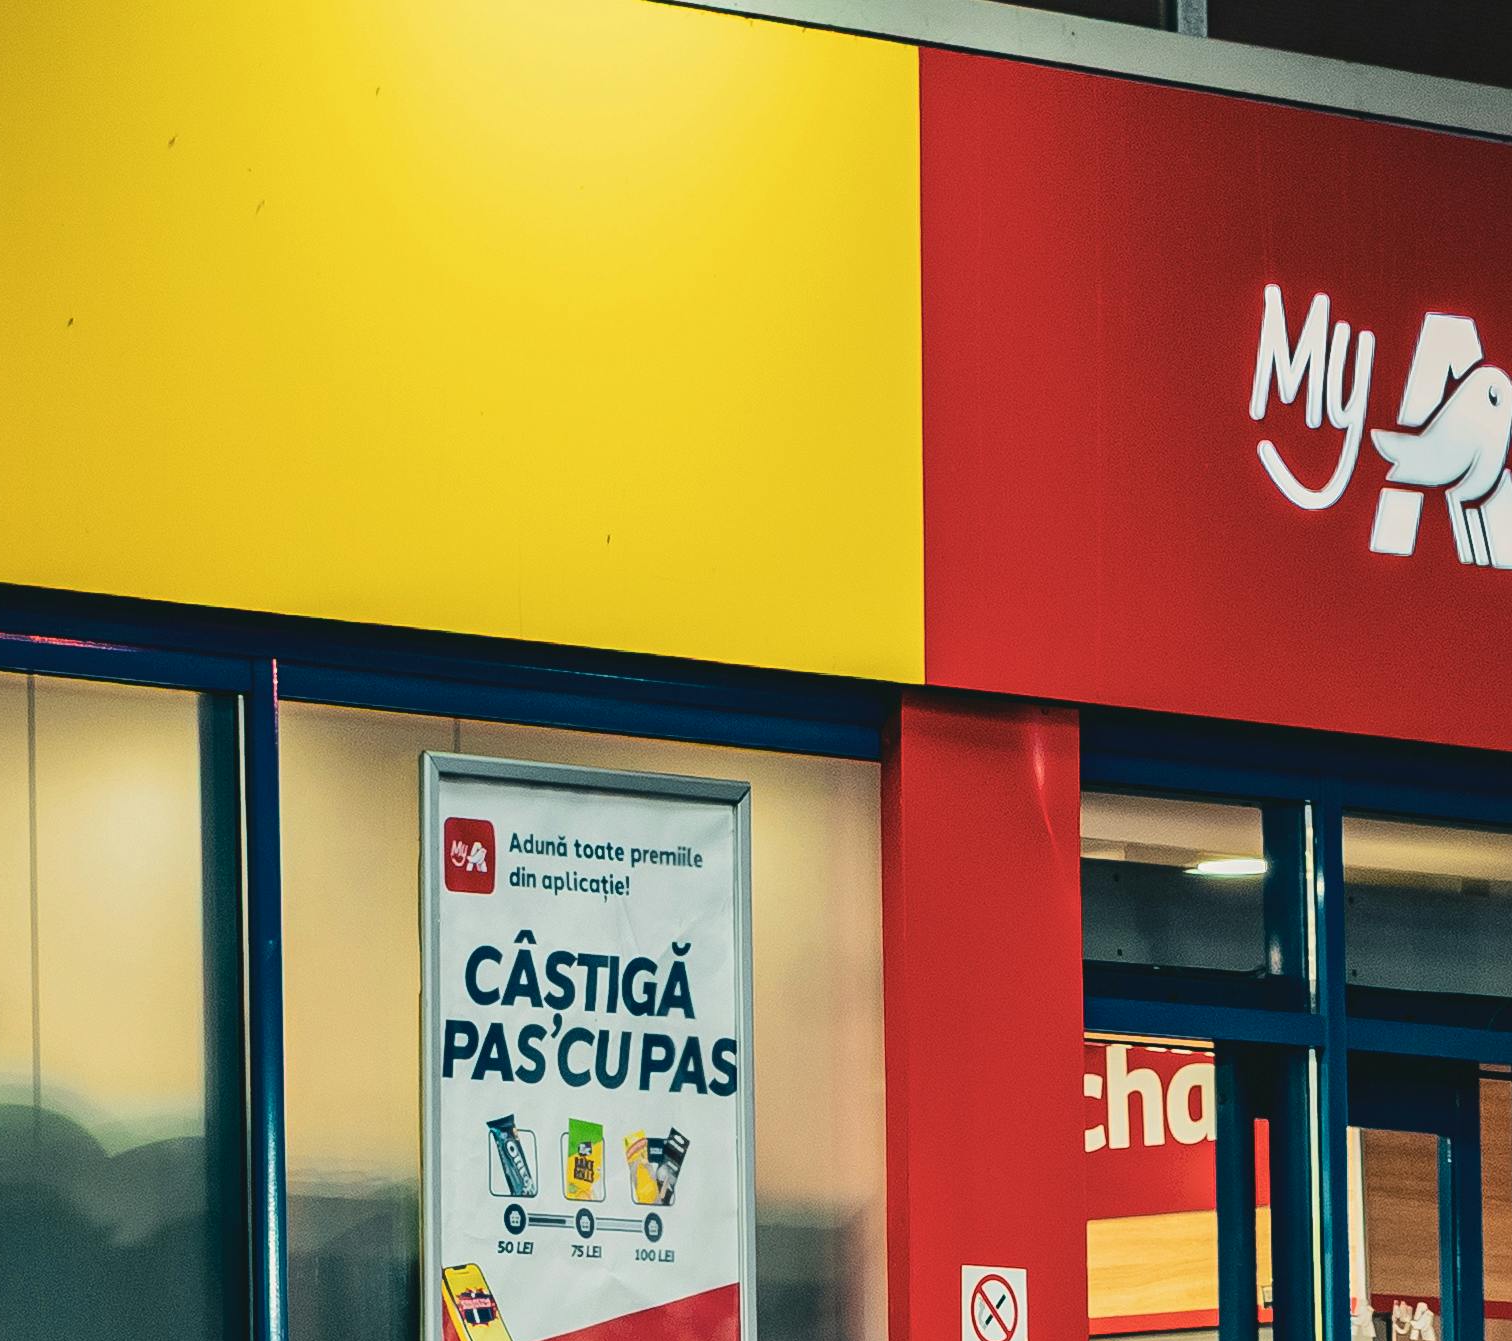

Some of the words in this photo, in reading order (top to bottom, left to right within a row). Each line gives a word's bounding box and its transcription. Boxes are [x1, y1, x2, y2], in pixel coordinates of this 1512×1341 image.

[1249, 283, 1375, 510] My
[508, 832, 568, 857] Adună
[574, 838, 625, 862] toate
[630, 846, 703, 868] premiile
[508, 866, 537, 888] din
[542, 871, 630, 903] aplicație!
[465, 929, 696, 1038] CÂȘTIGĂ
[442, 1019, 546, 1084] PAS
[557, 1027, 632, 1090] CU
[639, 1032, 737, 1097] PAS
[498, 1241, 514, 1254] 50
[516, 1242, 534, 1255] LEI
[570, 1245, 584, 1258] 75
[586, 1245, 602, 1258] LEI
[634, 1249, 656, 1262] 100
[658, 1250, 675, 1263] LEI
